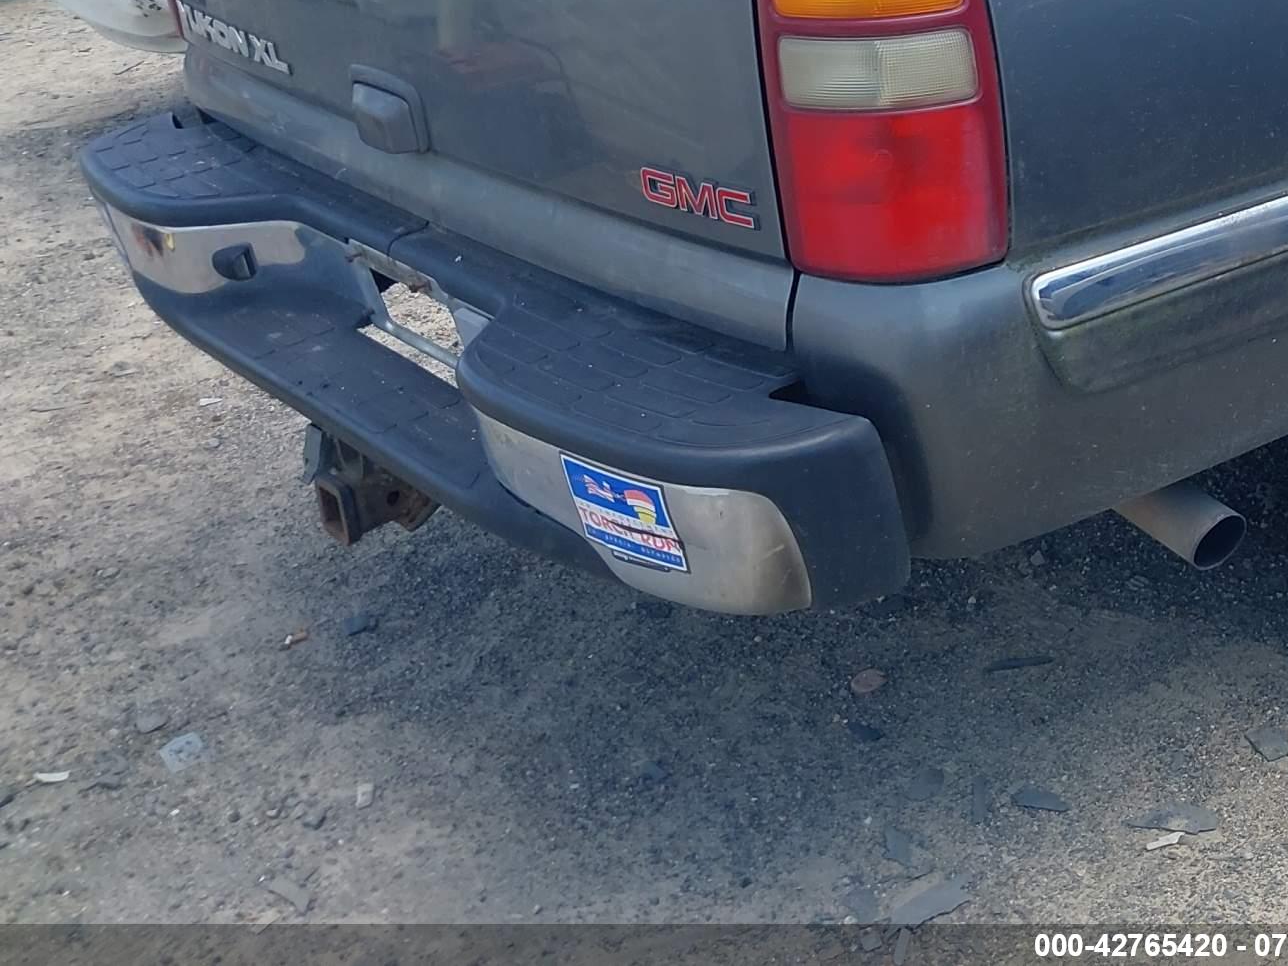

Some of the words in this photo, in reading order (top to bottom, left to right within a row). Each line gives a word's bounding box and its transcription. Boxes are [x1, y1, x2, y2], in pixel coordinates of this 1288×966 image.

[176, 0, 249, 57] YUKON
[248, 34, 291, 75] XL
[640, 166, 756, 229] GMC
